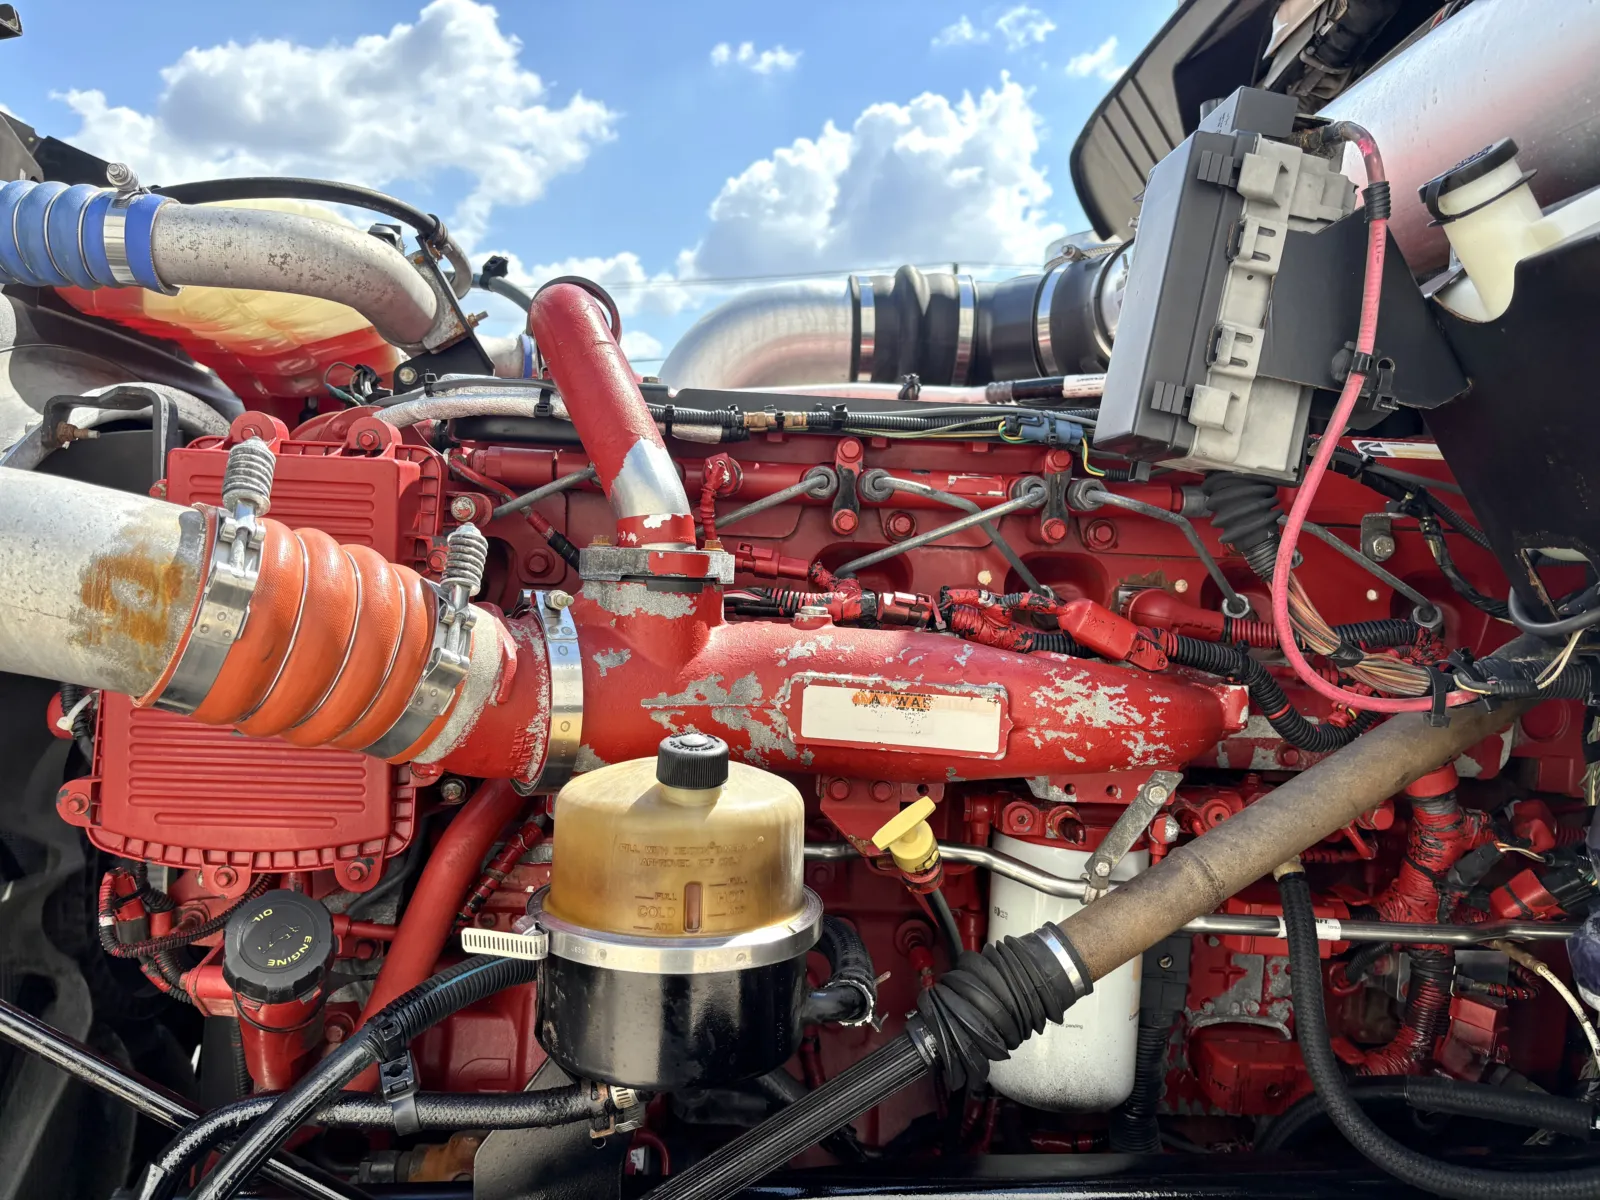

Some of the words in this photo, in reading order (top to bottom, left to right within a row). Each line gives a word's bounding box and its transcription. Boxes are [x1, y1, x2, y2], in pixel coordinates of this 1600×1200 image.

[655, 891, 678, 901] FULL
[251, 908, 273, 923] OIL
[637, 904, 676, 919] COLD
[267, 935, 313, 967] ENGINE
